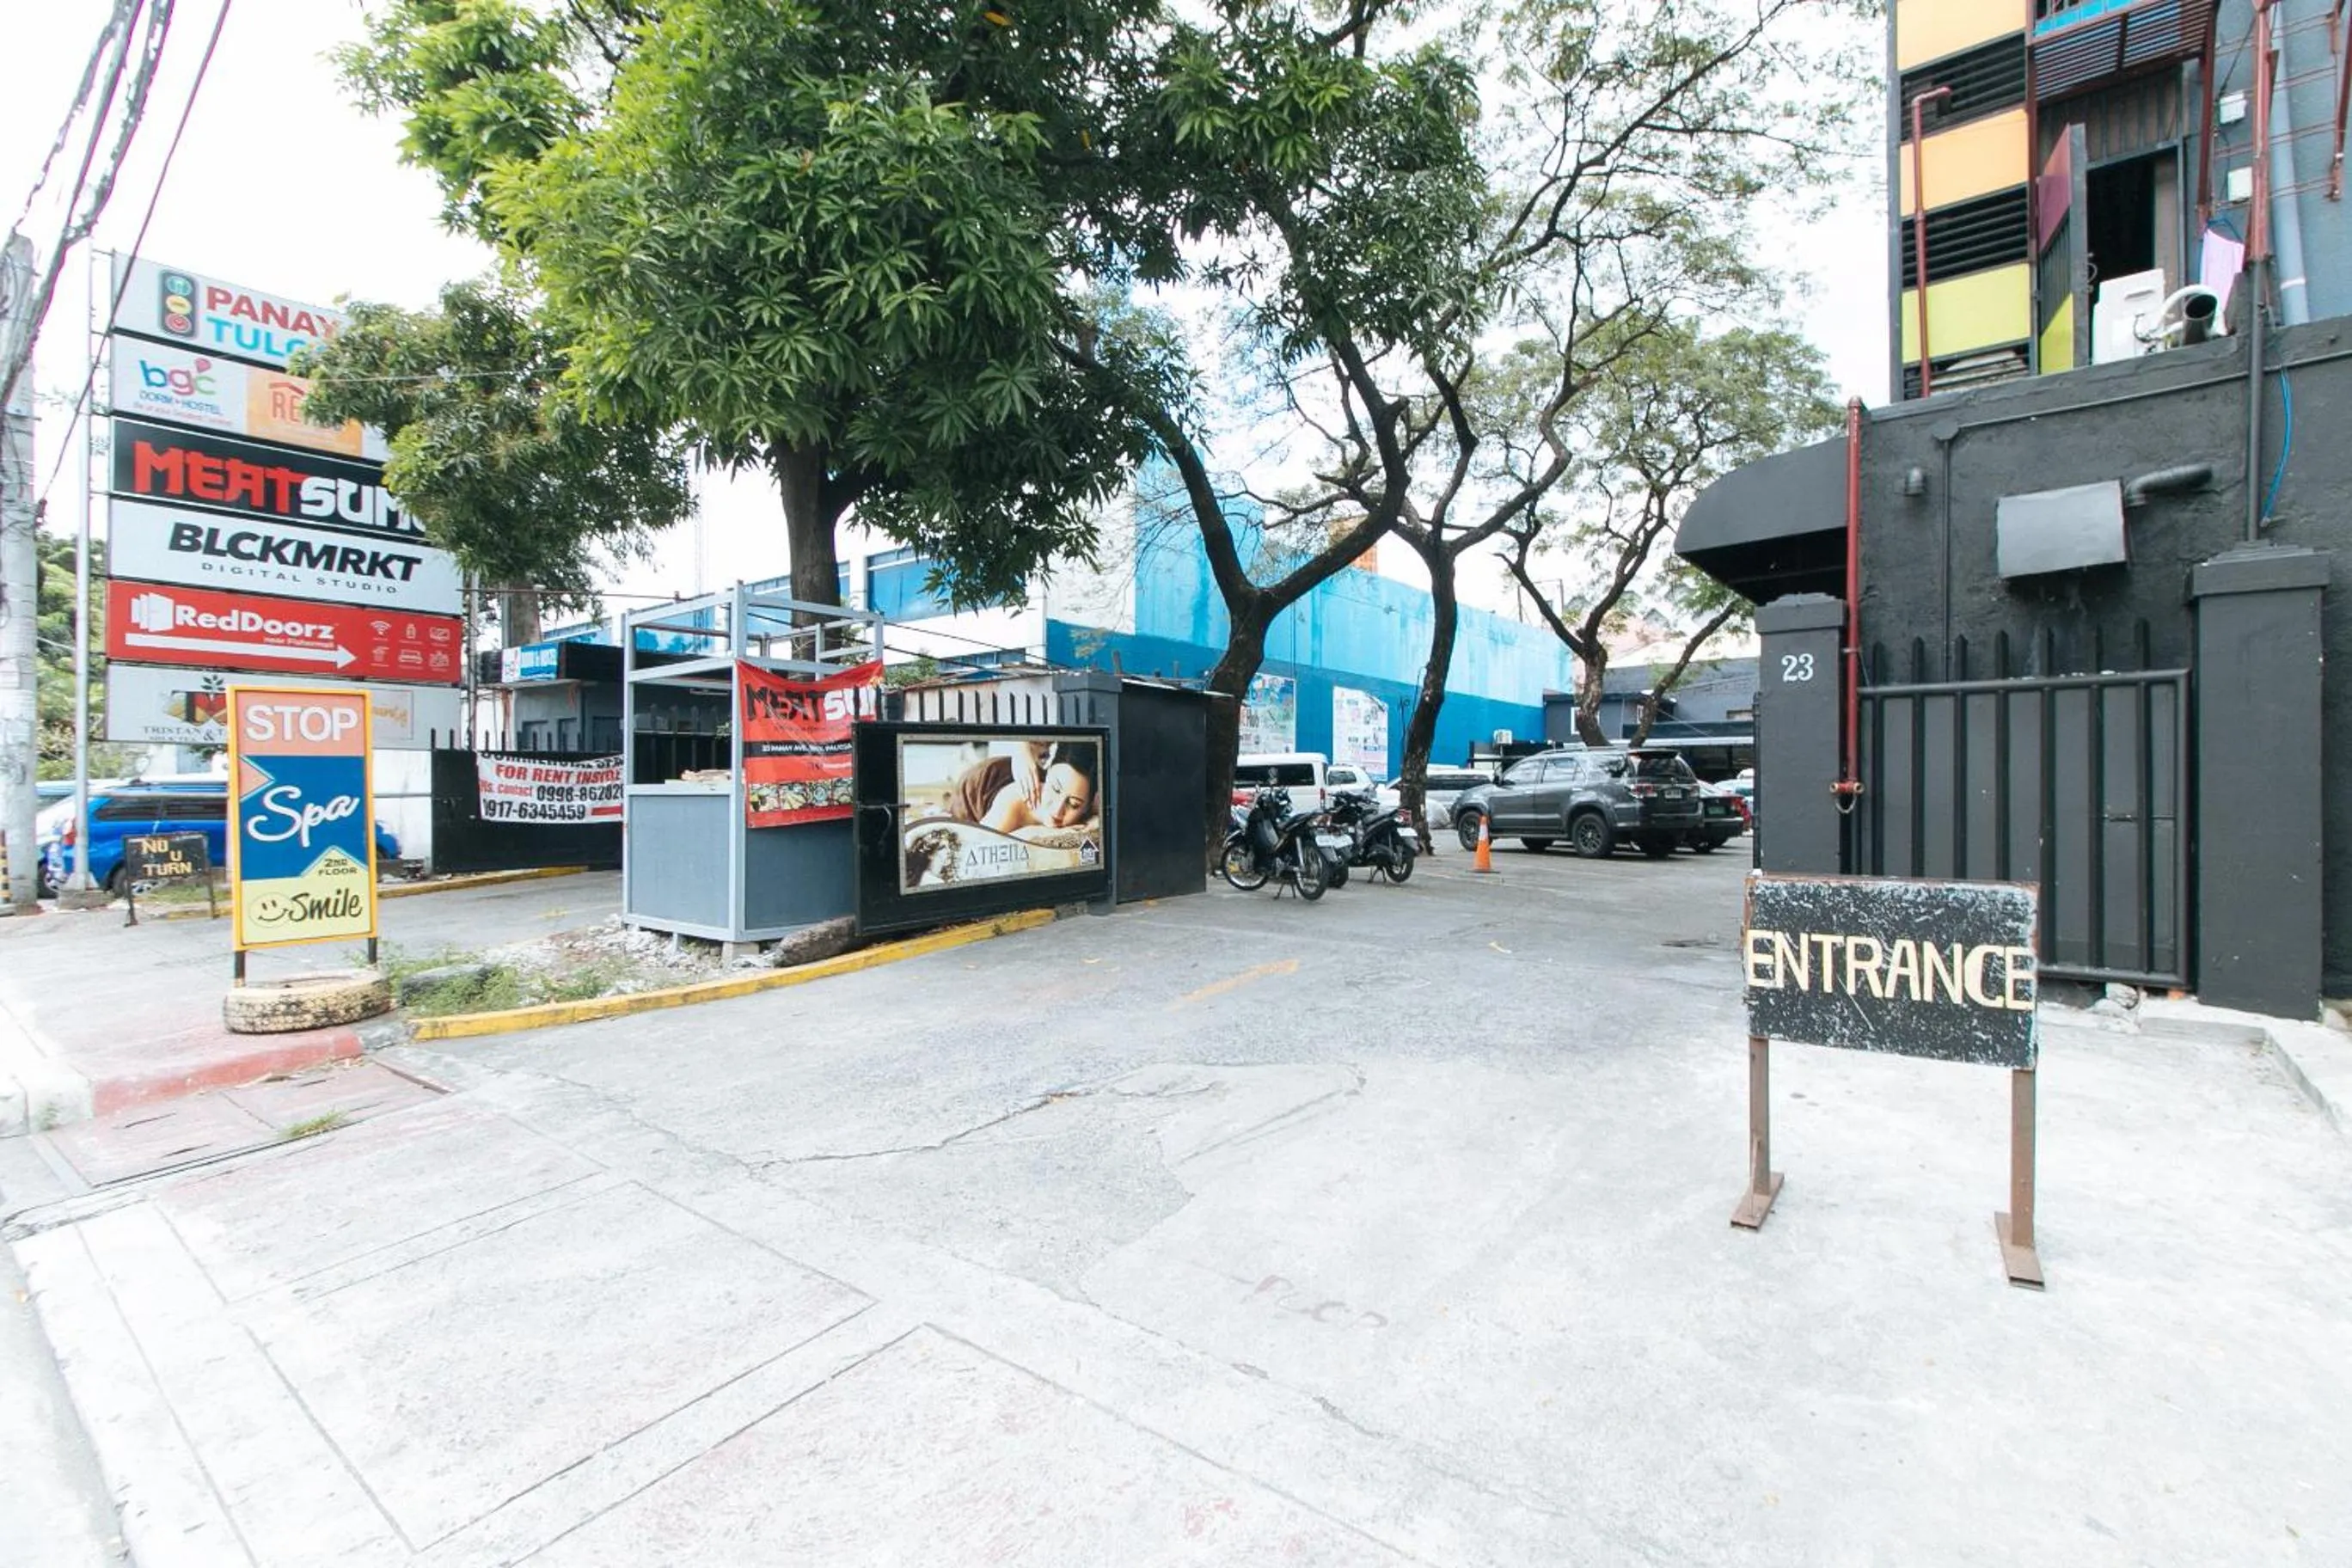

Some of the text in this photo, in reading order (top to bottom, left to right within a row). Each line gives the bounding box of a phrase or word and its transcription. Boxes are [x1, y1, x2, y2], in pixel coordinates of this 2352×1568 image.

[138, 359, 217, 396] bgc
[134, 440, 426, 532] MEATSUM
[168, 522, 422, 582] BLCKMRKT
[201, 562, 397, 594] DIGITAL STUDIO
[175, 604, 335, 640] RedDoorz
[1780, 652, 1815, 683] 23
[245, 705, 358, 742] STOP
[495, 764, 527, 781] FOR
[532, 768, 574, 784] RENT
[247, 785, 360, 848] Spa
[140, 837, 168, 854] NO
[169, 850, 182, 862] U
[142, 861, 193, 877] TURN
[317, 867, 358, 876] FLOOR
[289, 888, 362, 922] Smile
[1745, 928, 2036, 1012] ENTRANCE
